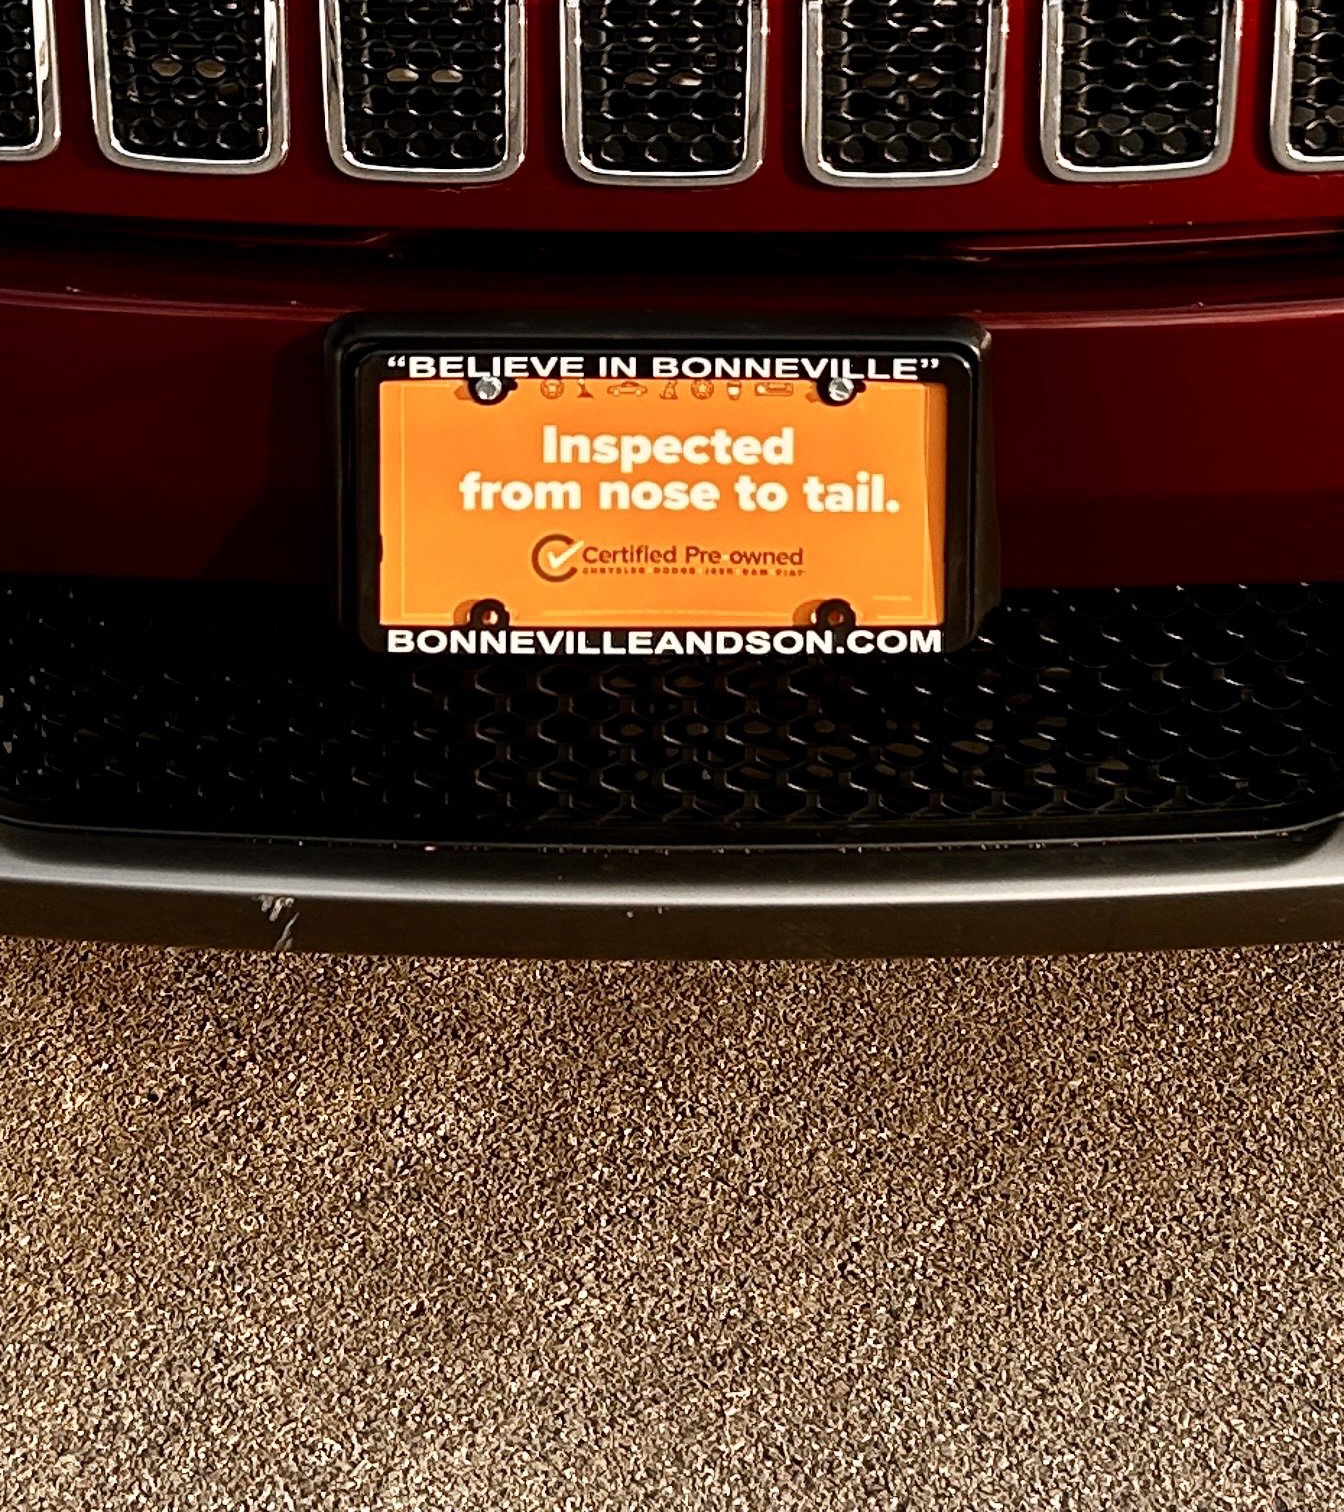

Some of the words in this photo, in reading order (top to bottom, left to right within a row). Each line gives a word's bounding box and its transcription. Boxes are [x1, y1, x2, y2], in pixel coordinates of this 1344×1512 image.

[599, 356, 637, 378] IN
[543, 424, 794, 473] Inspected
[459, 471, 582, 511] from
[599, 479, 721, 511] nose
[735, 476, 789, 512] to
[803, 472, 900, 514] tail.
[582, 544, 677, 564] Certified
[387, 629, 942, 655] BONNEVILLEANDSON.COM
